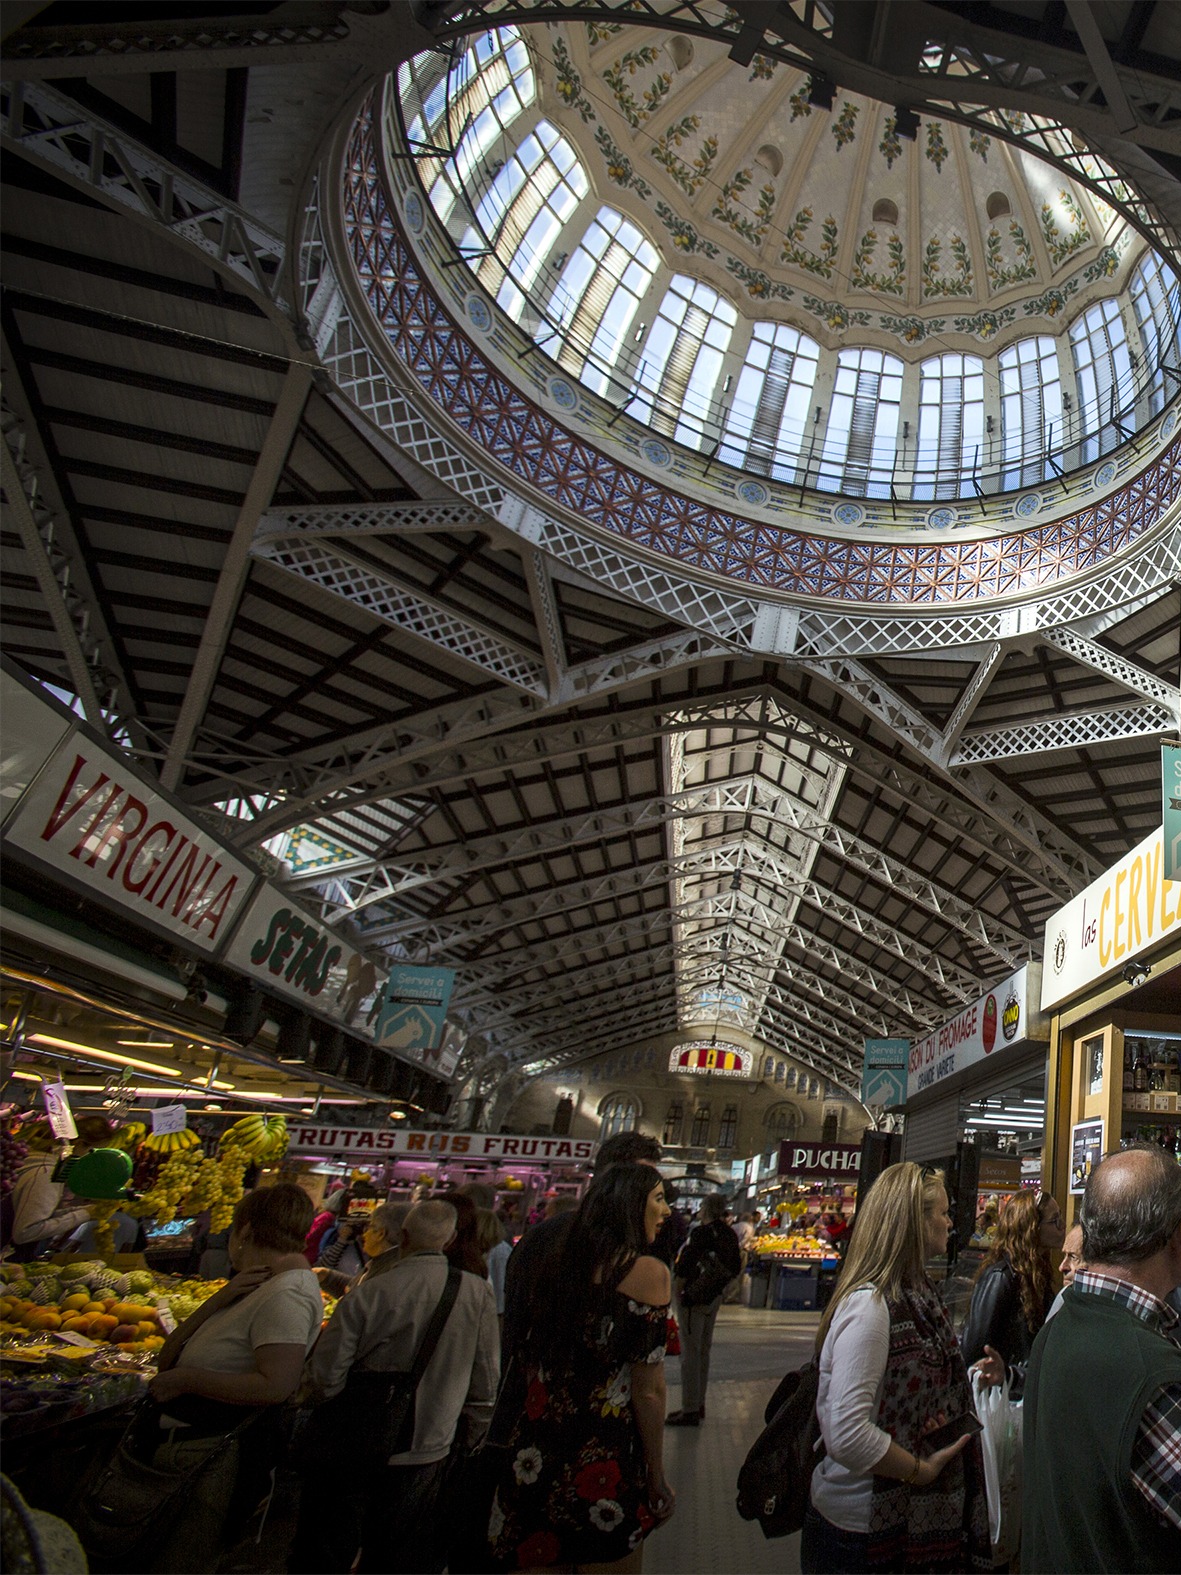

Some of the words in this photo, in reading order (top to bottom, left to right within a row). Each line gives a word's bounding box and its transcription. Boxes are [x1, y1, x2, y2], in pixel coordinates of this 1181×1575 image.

[40, 754, 238, 940] VIRGINIA
[1081, 899, 1096, 949] las
[251, 908, 341, 996] SETAS
[399, 973, 434, 985] Servei
[871, 1045, 896, 1055] Servei
[926, 1036, 935, 1064] DU
[938, 1006, 977, 1056] FROMAGE
[870, 1055, 904, 1064] domicili
[484, 1137, 592, 1158] FRUTAS
